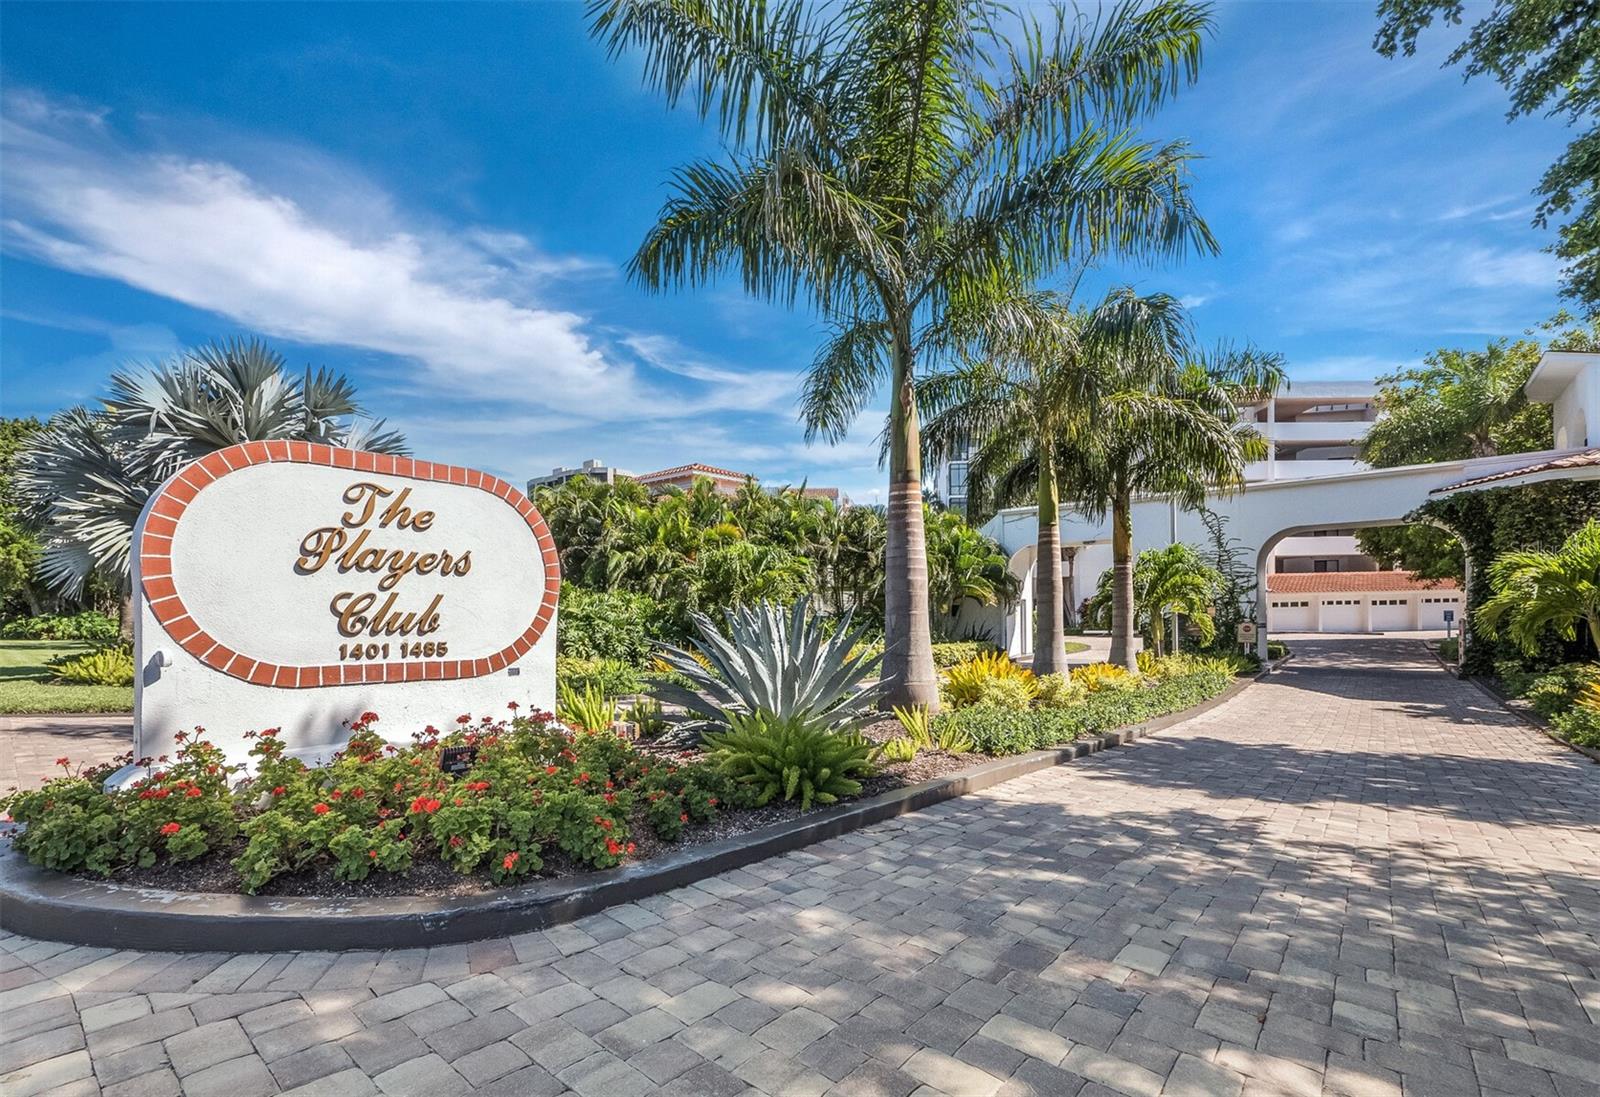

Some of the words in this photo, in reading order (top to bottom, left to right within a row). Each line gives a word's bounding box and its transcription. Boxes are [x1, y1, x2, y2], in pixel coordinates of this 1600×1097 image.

[341, 482, 435, 532] The
[293, 526, 472, 591] Players
[329, 592, 446, 638] Club
[339, 643, 390, 661] 1401
